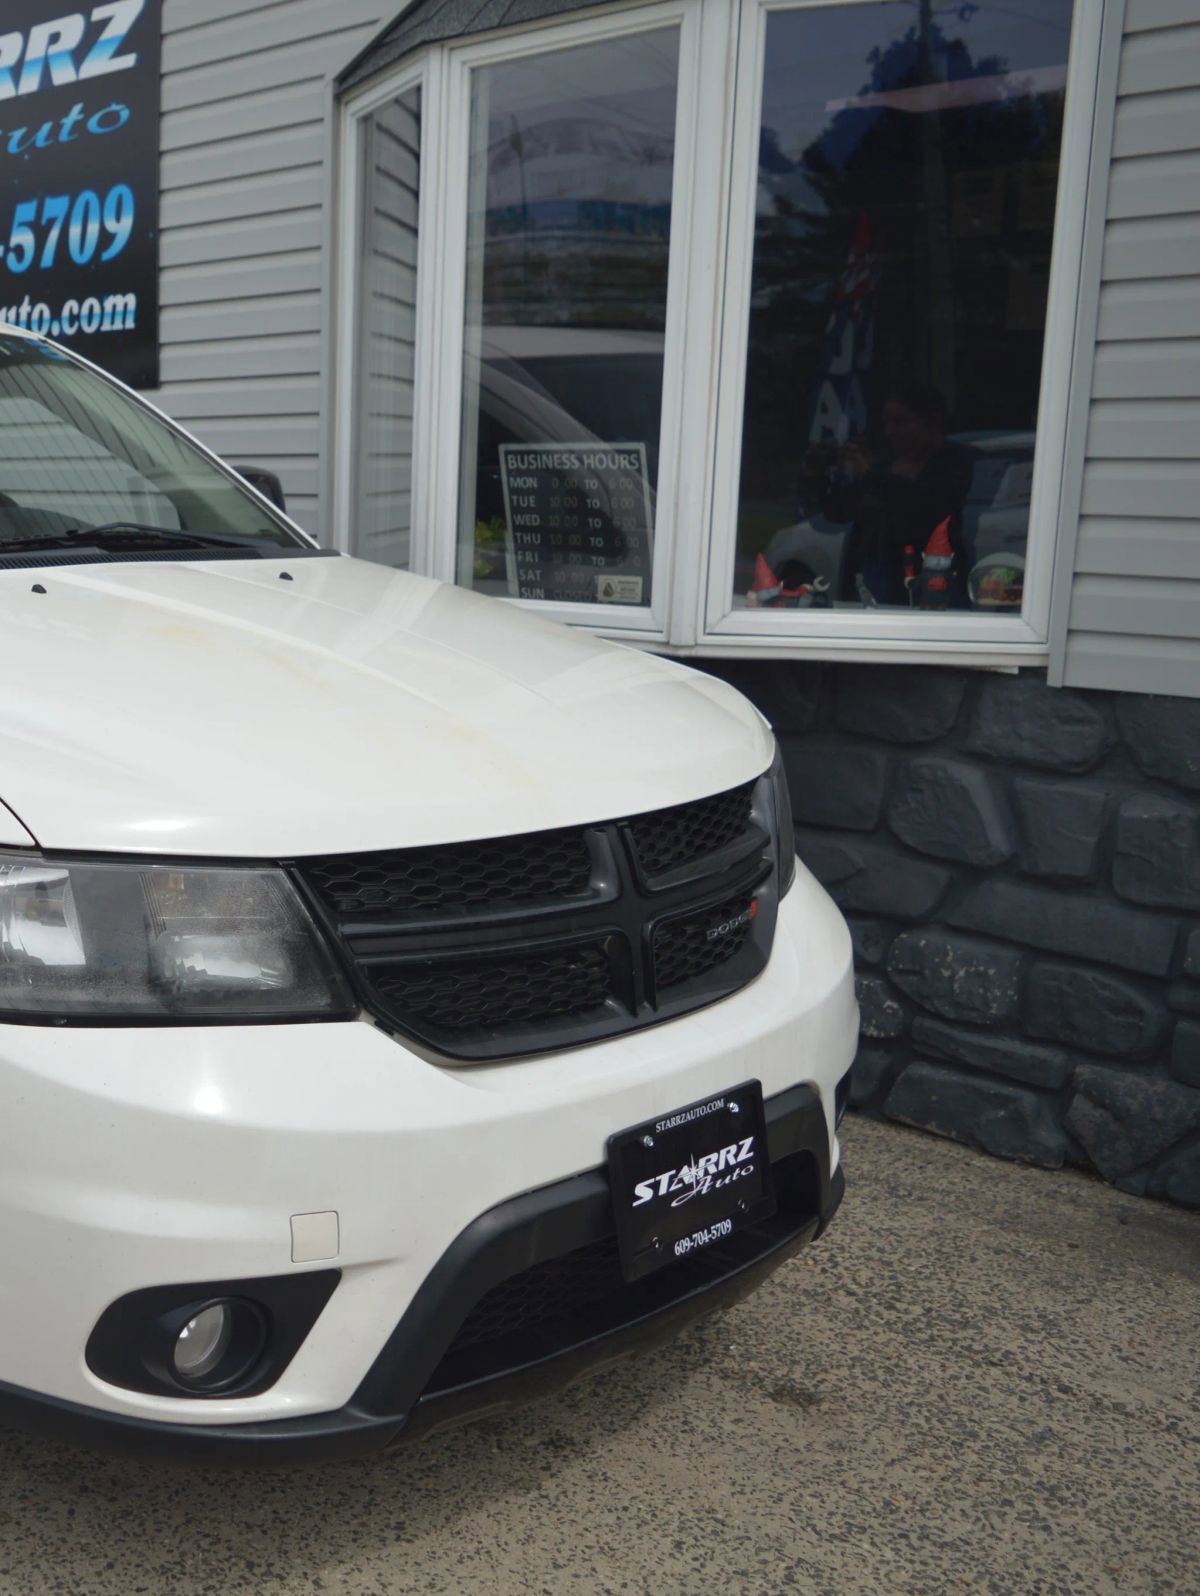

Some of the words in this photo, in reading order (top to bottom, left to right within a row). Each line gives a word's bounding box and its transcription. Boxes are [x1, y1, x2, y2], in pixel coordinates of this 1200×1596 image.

[507, 454, 580, 469] BUSINESS
[584, 453, 640, 469] HOURS
[509, 477, 538, 489] MON
[584, 479, 598, 490] TO
[511, 495, 537, 508] TUE
[586, 498, 600, 509] TO
[513, 514, 541, 527] WED
[588, 517, 602, 528] TO
[515, 532, 542, 545] THU
[590, 537, 604, 548] TO
[517, 551, 539, 563] FRI
[592, 556, 606, 567] TO
[519, 569, 542, 581] SAT
[521, 587, 545, 600] SUN
[655, 1098, 725, 1133] STARRZAUTO.COM
[632, 1136, 754, 1207] STARRZ
[670, 1164, 754, 1208] Auto
[674, 1218, 732, 1256] 609-704-5709
